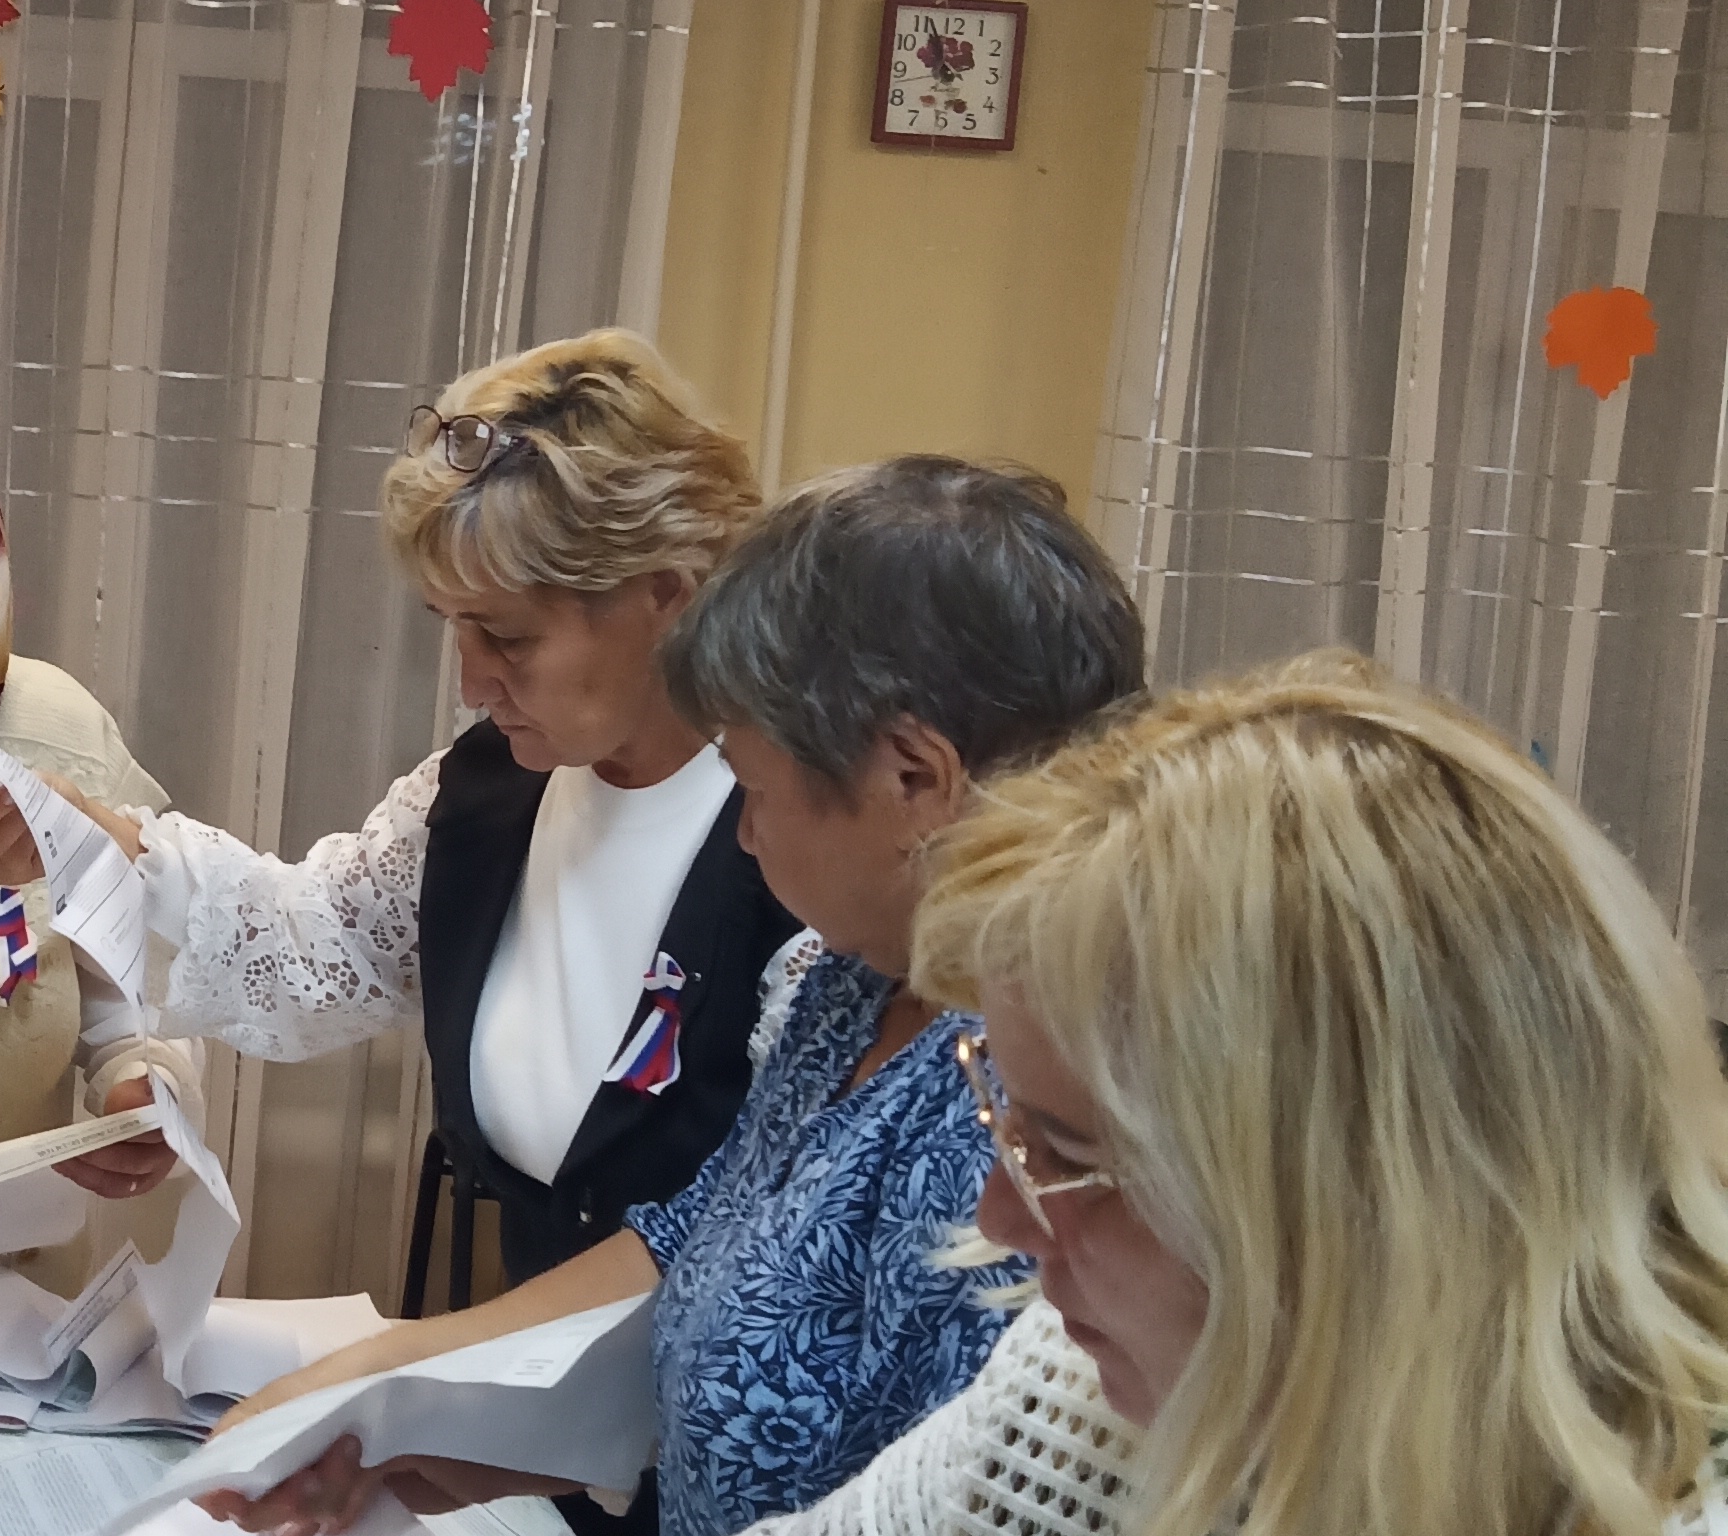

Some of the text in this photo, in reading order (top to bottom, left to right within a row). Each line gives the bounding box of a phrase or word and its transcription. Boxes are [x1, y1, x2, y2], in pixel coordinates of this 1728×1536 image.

[944, 17, 966, 36] 12
[978, 19, 985, 37] 1
[896, 33, 917, 52] 10
[988, 39, 1002, 57] 2
[893, 61, 908, 79] 9
[985, 67, 1000, 85] 3
[890, 89, 904, 106] 8
[982, 96, 998, 114] 4
[907, 109, 920, 127] 7
[962, 114, 977, 131] 5
